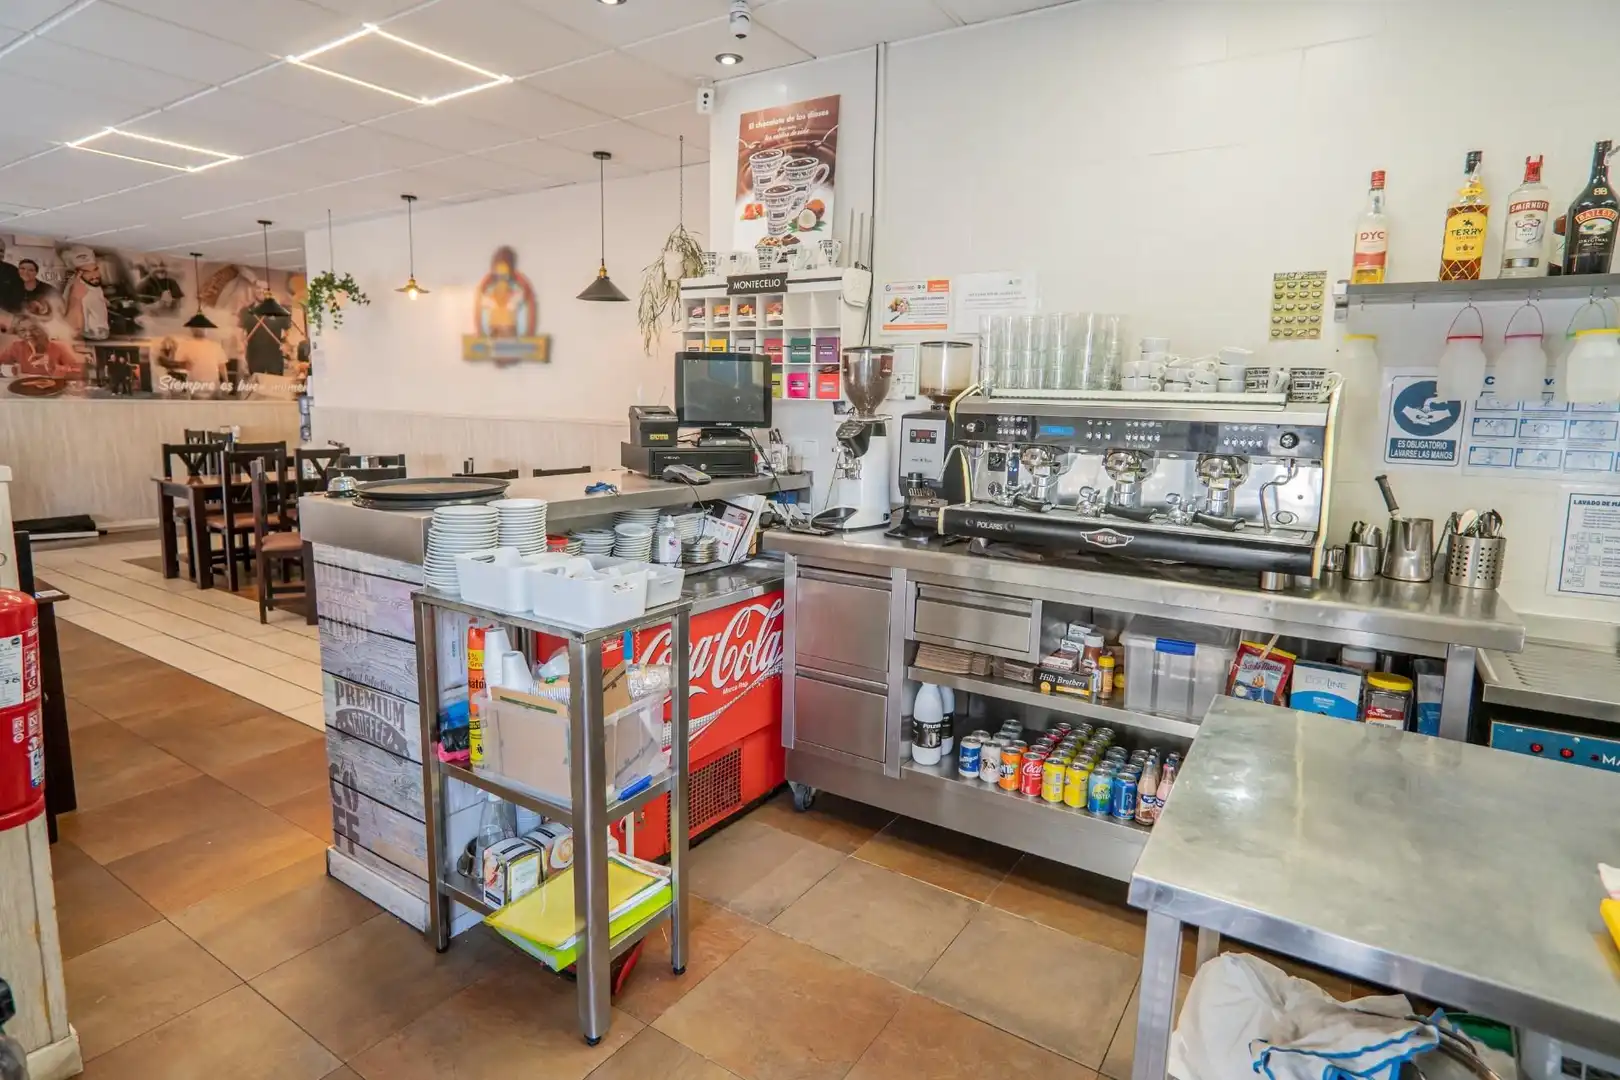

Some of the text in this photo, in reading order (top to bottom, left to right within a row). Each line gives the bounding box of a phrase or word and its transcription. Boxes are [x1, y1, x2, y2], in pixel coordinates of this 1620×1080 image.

[1360, 231, 1385, 241] DYC
[1450, 228, 1483, 237] TERRY
[733, 279, 781, 290] MONTECELIO
[158, 374, 216, 394] Siempre
[1397, 440, 1448, 450] ES OBLIGATORIO
[1390, 449, 1418, 458] LAVARSE
[1430, 451, 1453, 460] MANOS
[976, 520, 1003, 531] POLARIS
[1039, 672, 1086, 688] Hills Brothers
[334, 680, 406, 732] PREMIUM
[351, 711, 389, 747] COFFEE
